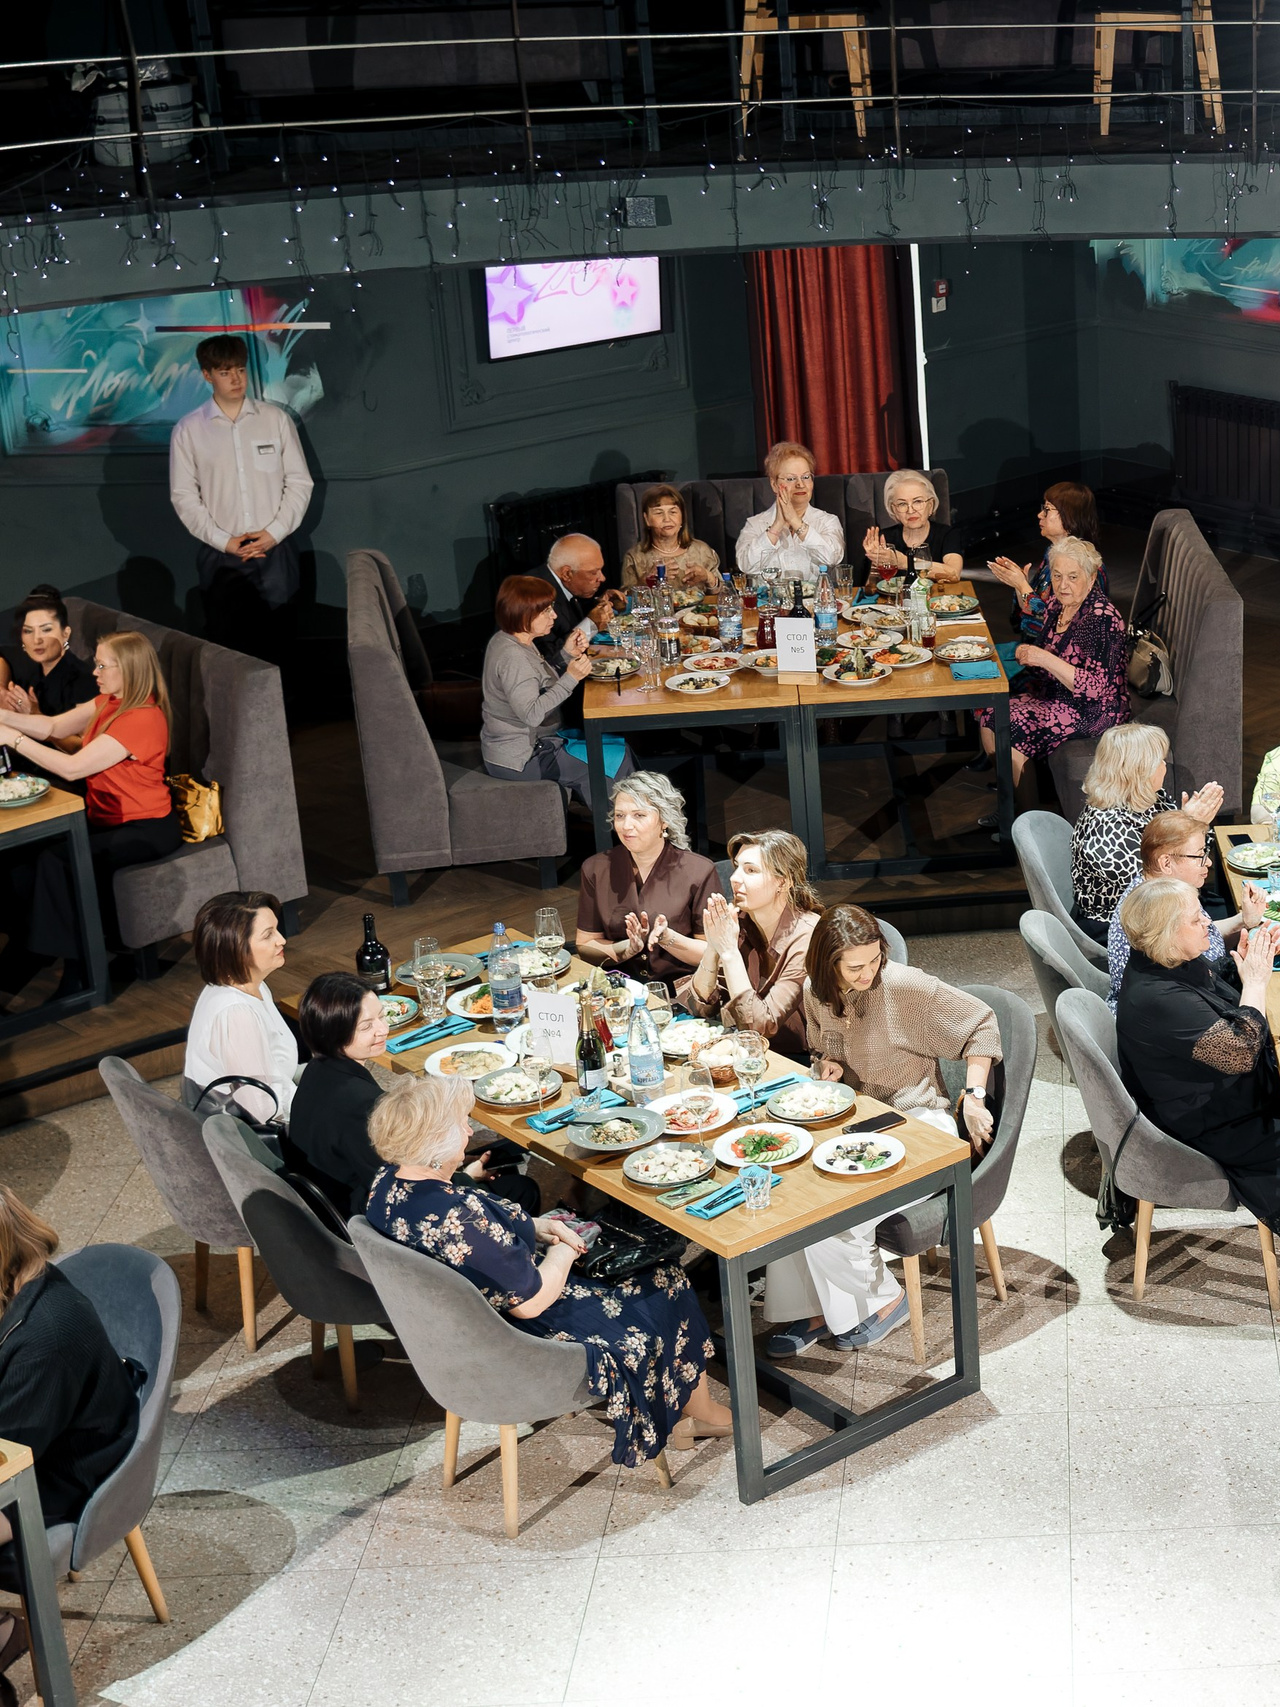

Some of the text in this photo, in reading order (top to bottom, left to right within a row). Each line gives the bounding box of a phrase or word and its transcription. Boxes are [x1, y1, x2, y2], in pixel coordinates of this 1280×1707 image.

[786, 633, 808, 641] СТОЛ
[790, 646, 805, 654] №5
[538, 1011, 565, 1023] СТОЛ
[543, 1028, 562, 1038] №4
